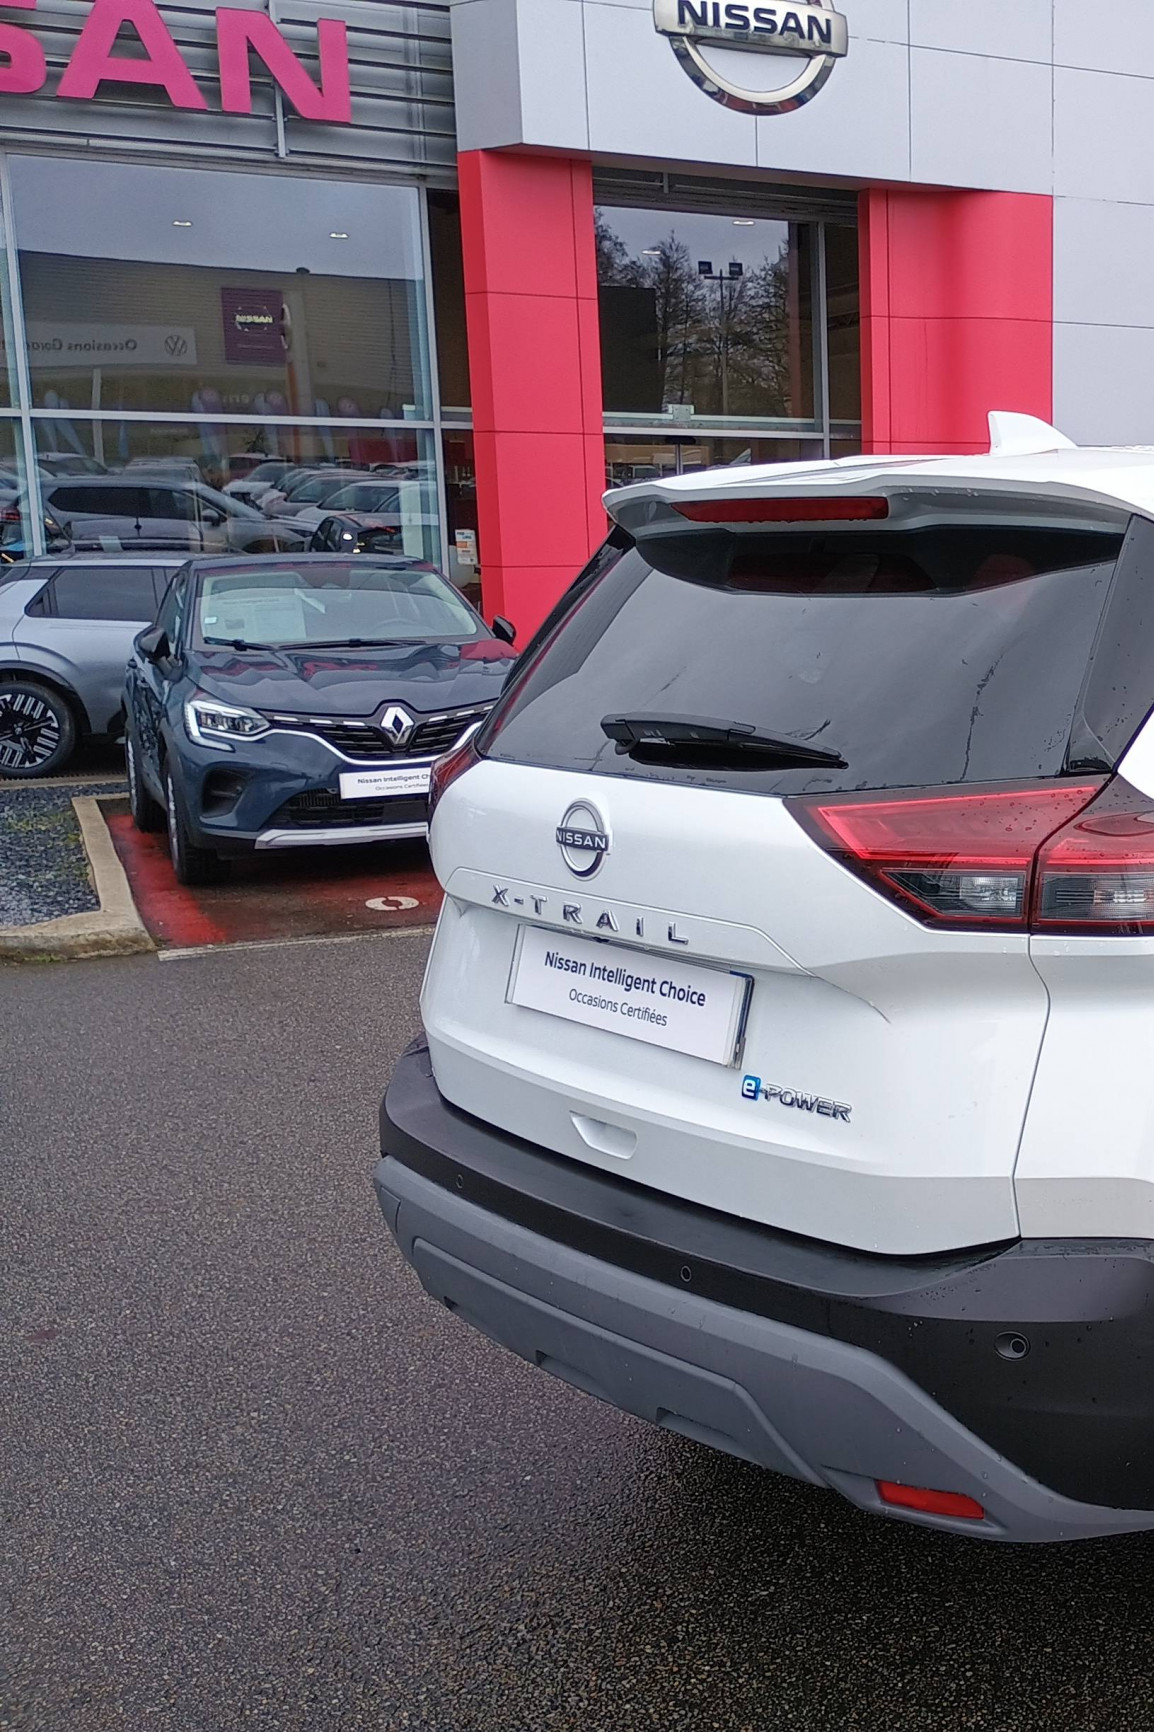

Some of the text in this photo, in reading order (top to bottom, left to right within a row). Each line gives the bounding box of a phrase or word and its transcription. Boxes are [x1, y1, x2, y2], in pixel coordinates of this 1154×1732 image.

[677, 0, 832, 44] NISSAN
[357, 777, 382, 785] Nissan
[383, 774, 420, 783] Intelligent
[556, 829, 606, 849] NISSAN
[491, 884, 690, 946] X-TRAIL
[544, 951, 707, 1007] Nissan Intelligent Choice
[569, 988, 668, 1027] Occasions Certifiées
[741, 1075, 853, 1124] e-POWER
